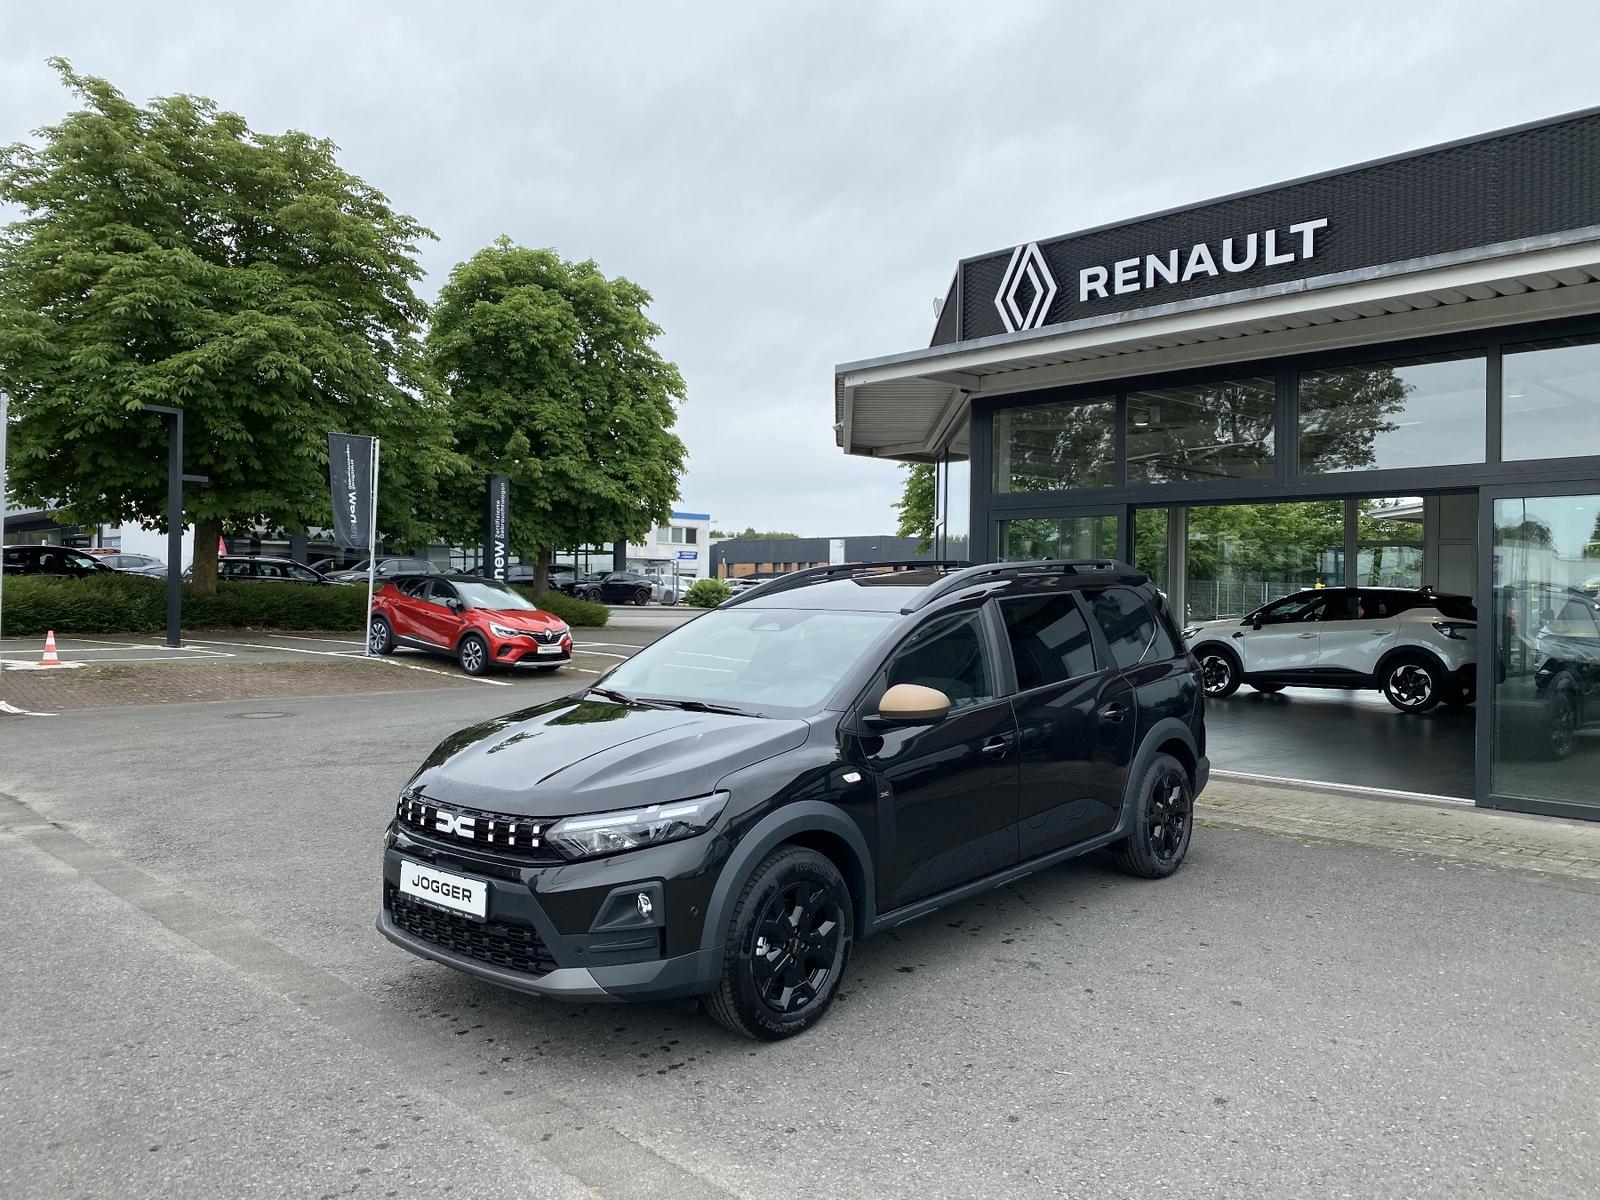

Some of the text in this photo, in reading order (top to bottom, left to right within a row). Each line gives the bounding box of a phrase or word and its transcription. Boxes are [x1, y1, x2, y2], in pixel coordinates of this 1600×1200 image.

[1079, 217, 1328, 302] RENAULT
[493, 540, 505, 581] new
[411, 874, 472, 903] JOGGER
